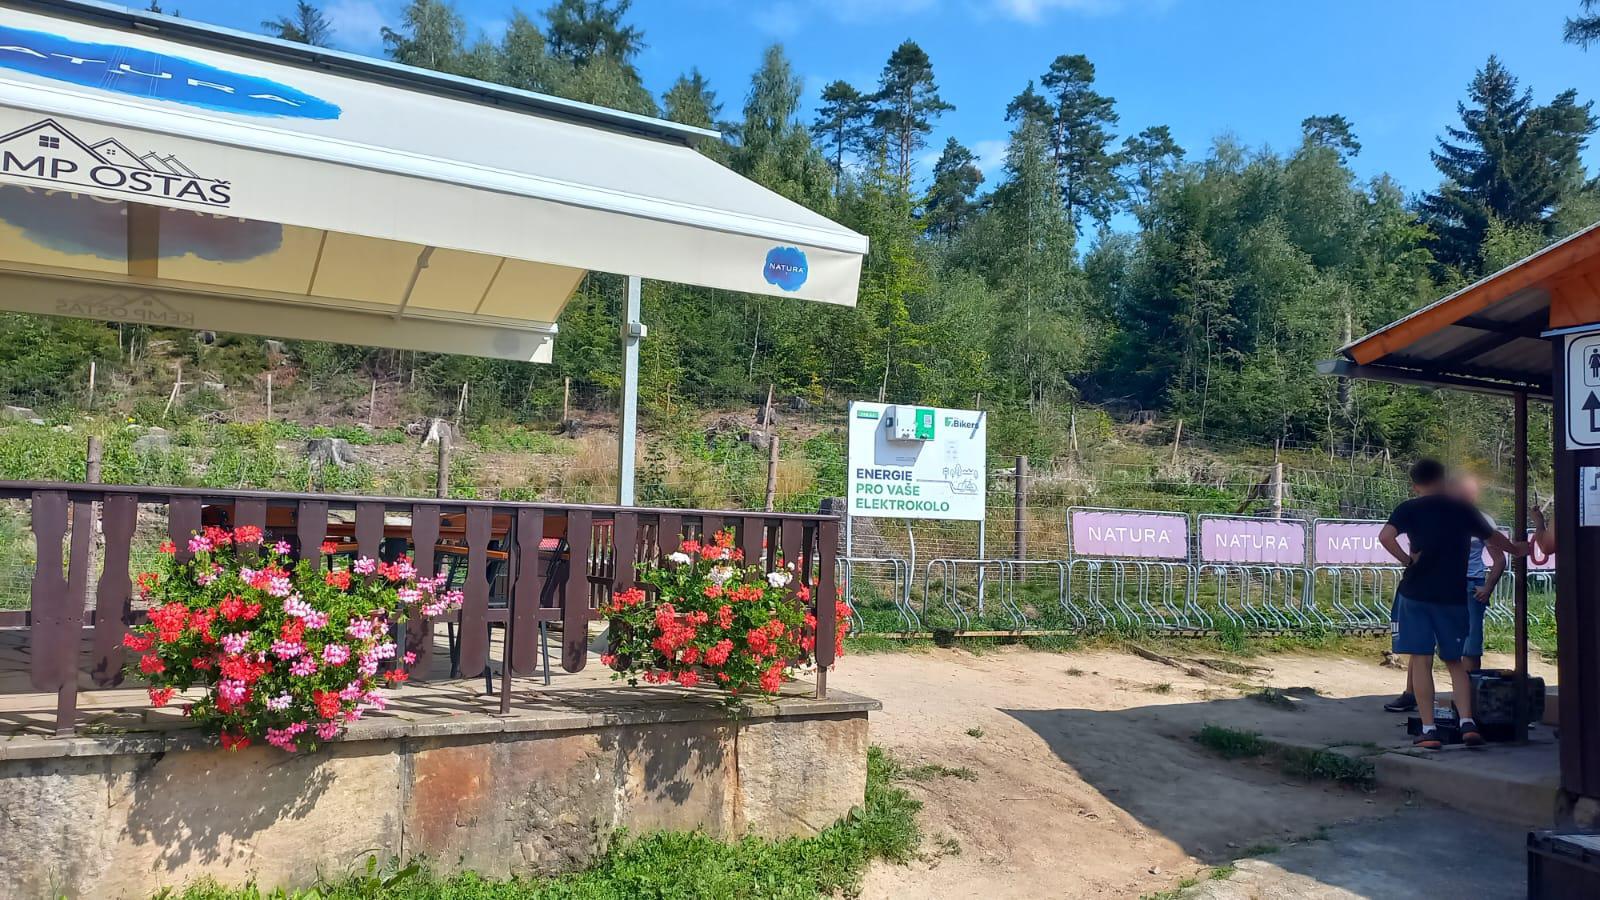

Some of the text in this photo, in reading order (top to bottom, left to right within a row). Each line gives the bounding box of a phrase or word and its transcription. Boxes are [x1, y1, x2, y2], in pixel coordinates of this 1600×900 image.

[0, 45, 301, 107] ATURA
[2, 150, 79, 178] MP
[89, 165, 232, 205] OSTAŠ
[769, 263, 804, 273] NATURA
[856, 468, 913, 481] ENERGIE
[856, 483, 920, 496] PRO VAŠE
[855, 498, 950, 512] ELEKTROKOLO
[1088, 526, 1170, 543] NATURA
[1215, 533, 1289, 549] NATURA
[1328, 536, 1384, 550] NATUR
